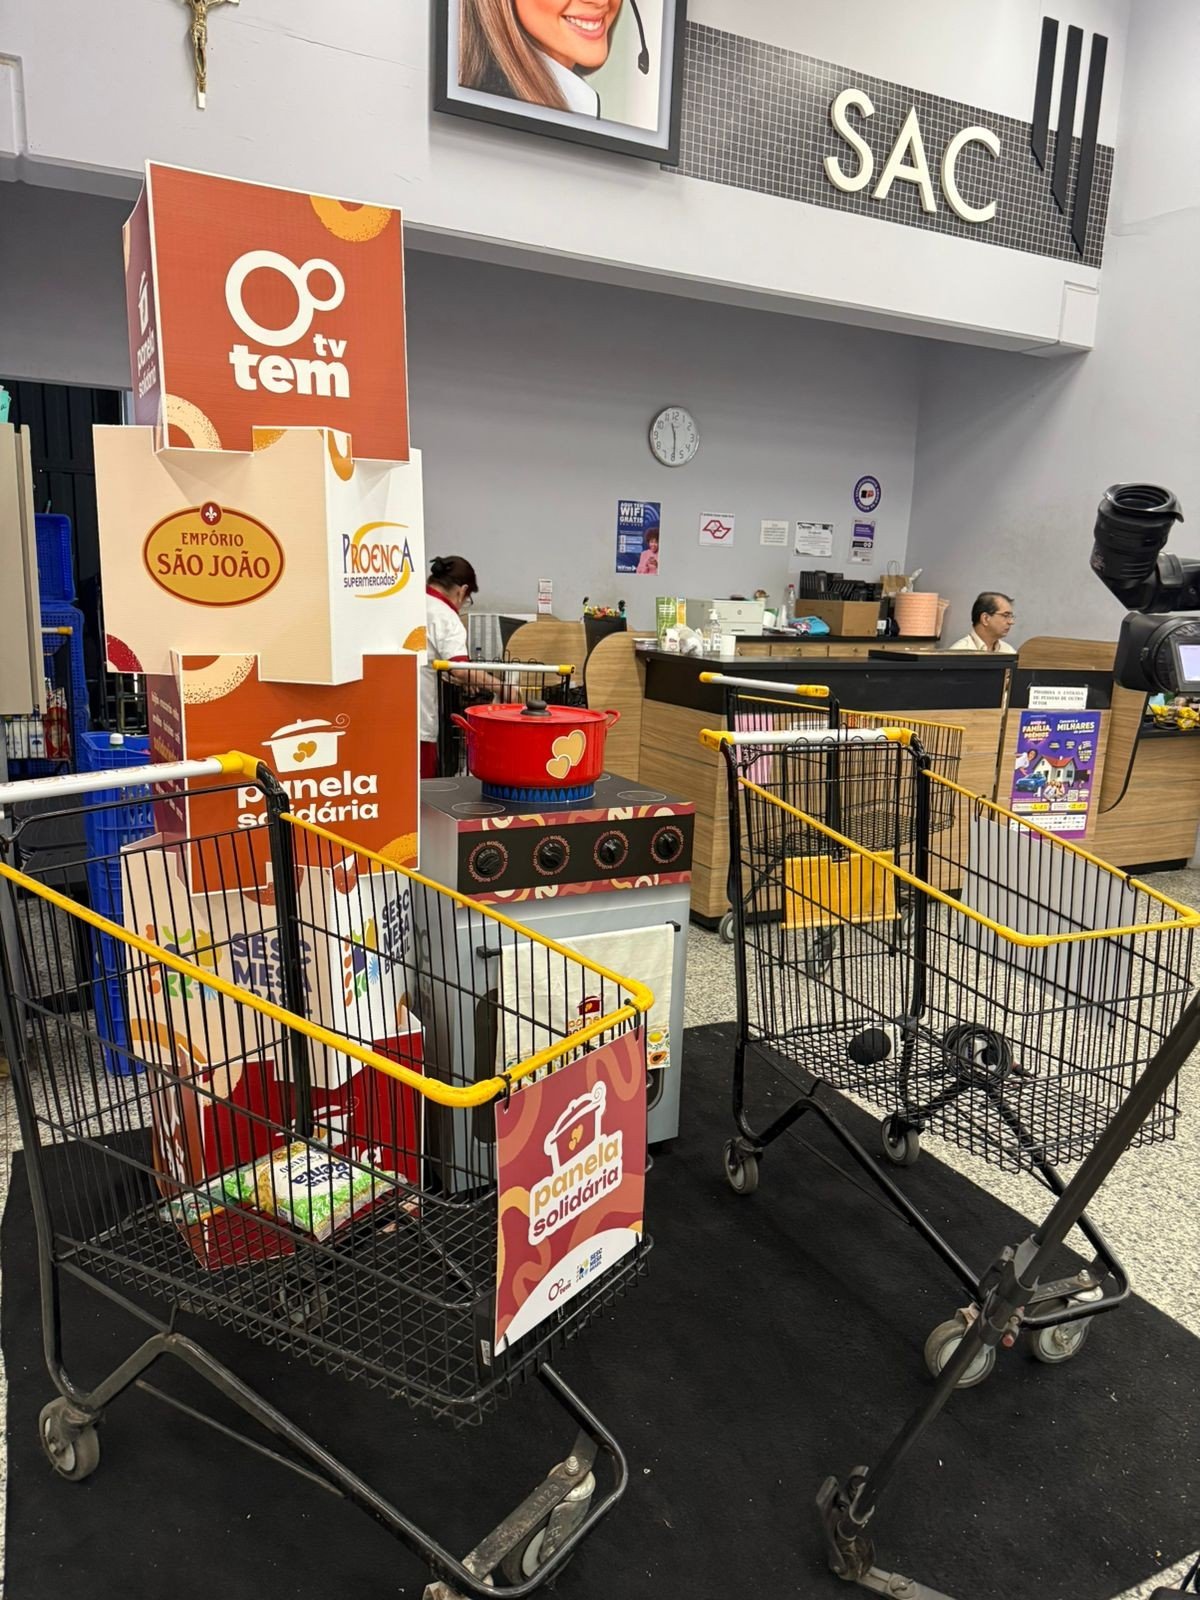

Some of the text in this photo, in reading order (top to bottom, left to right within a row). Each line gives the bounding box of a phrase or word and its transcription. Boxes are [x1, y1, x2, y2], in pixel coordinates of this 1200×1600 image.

[823, 87, 1001, 223] SAC
[313, 333, 347, 359] tv
[228, 344, 351, 398] tem
[620, 507, 644, 517] WIFI
[181, 530, 244, 547] EMPÓRIO
[157, 548, 270, 579] SÃO JOÃO
[342, 533, 415, 579] PROENÇA
[1057, 721, 1095, 731] MILHARES
[237, 799, 379, 829] soidária
[534, 1138, 619, 1217] panela
[533, 1166, 619, 1237] solidária
